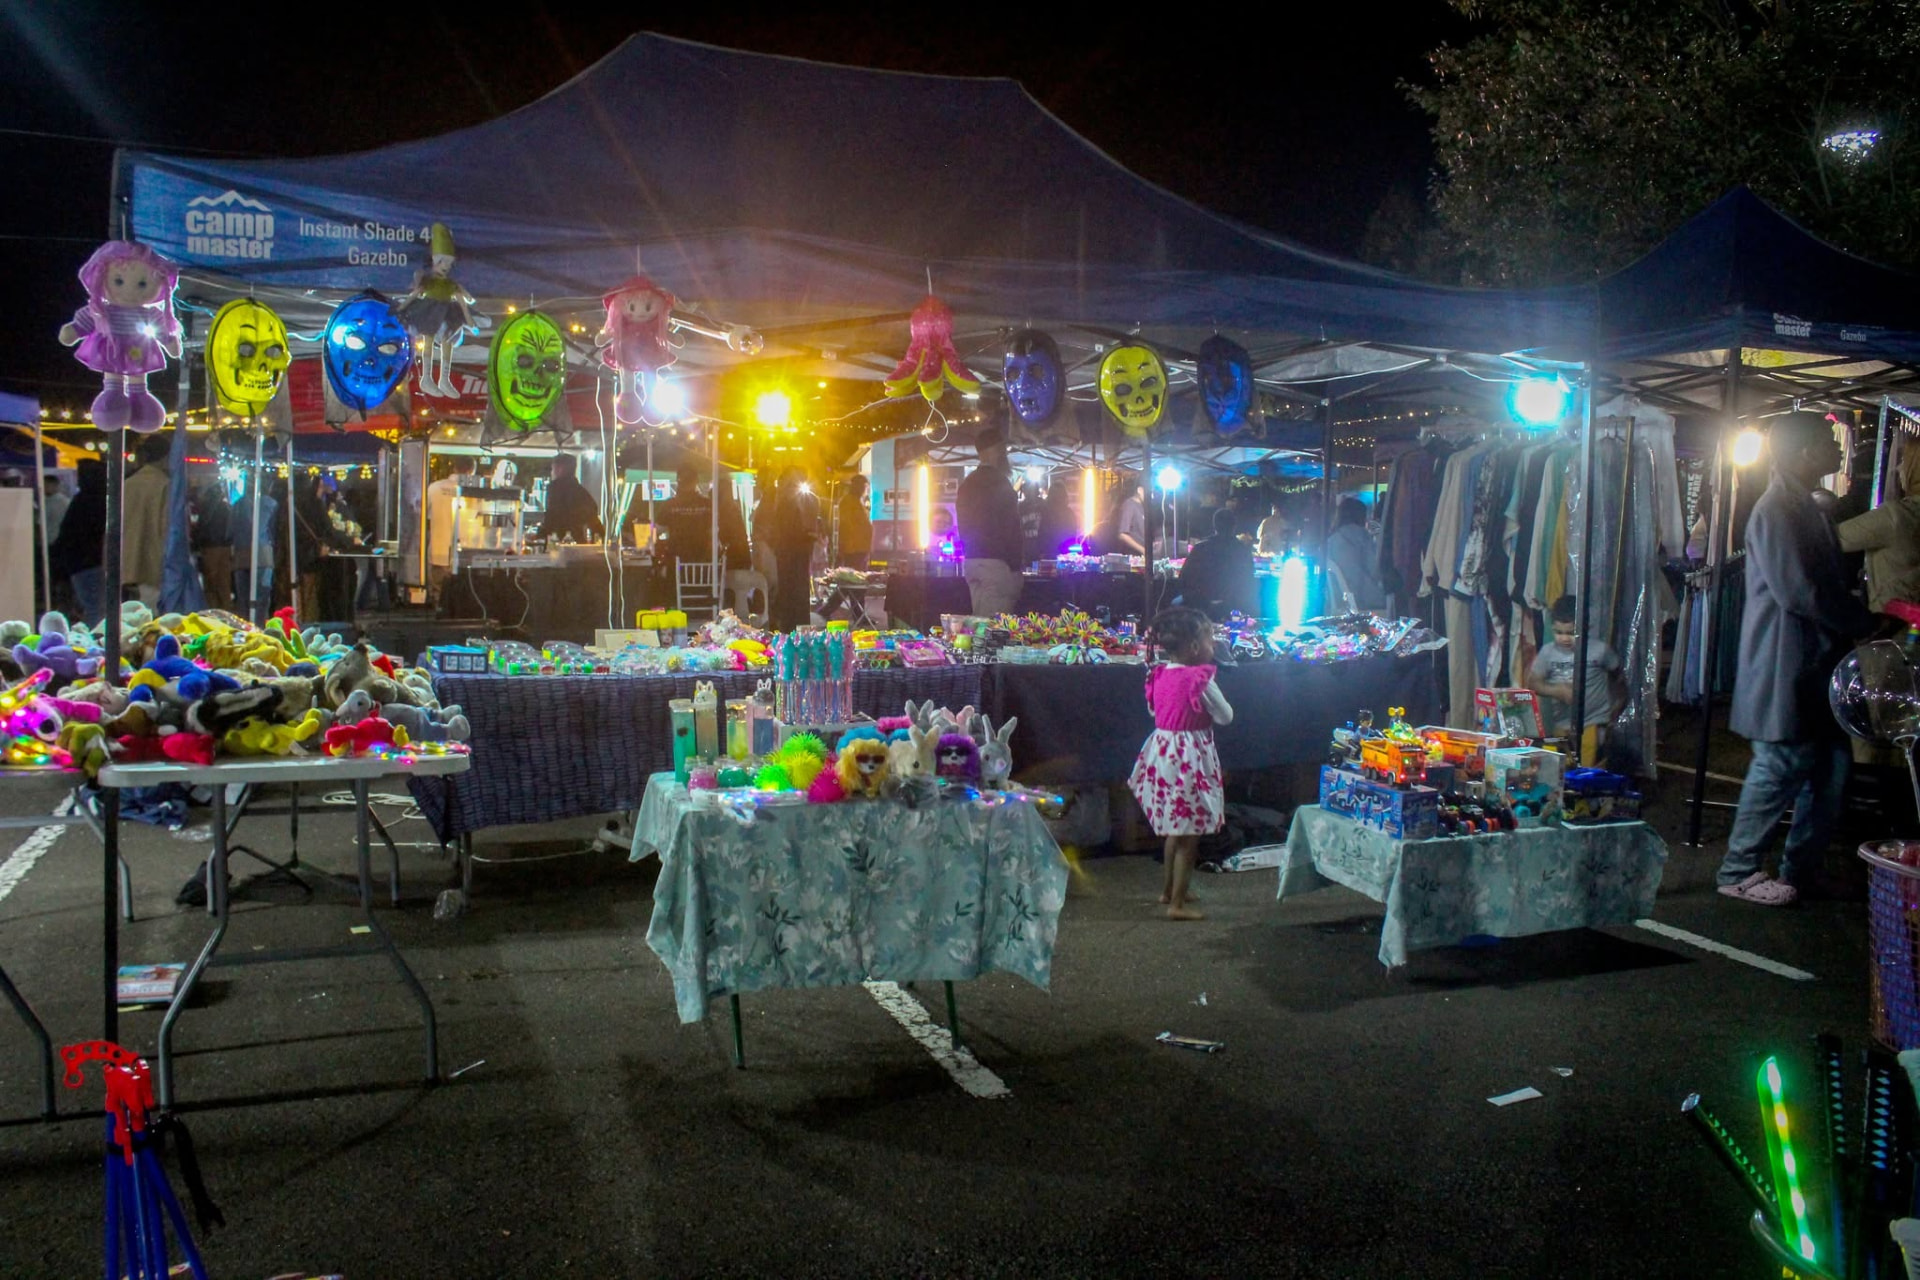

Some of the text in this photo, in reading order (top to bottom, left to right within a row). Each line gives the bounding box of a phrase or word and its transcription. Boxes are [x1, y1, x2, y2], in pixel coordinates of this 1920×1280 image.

[185, 210, 275, 241] camp
[300, 217, 359, 240] Instant
[364, 222, 415, 242] Shade
[187, 236, 275, 259] master
[348, 246, 408, 267] Gazebo
[1774, 323, 1811, 337] master
